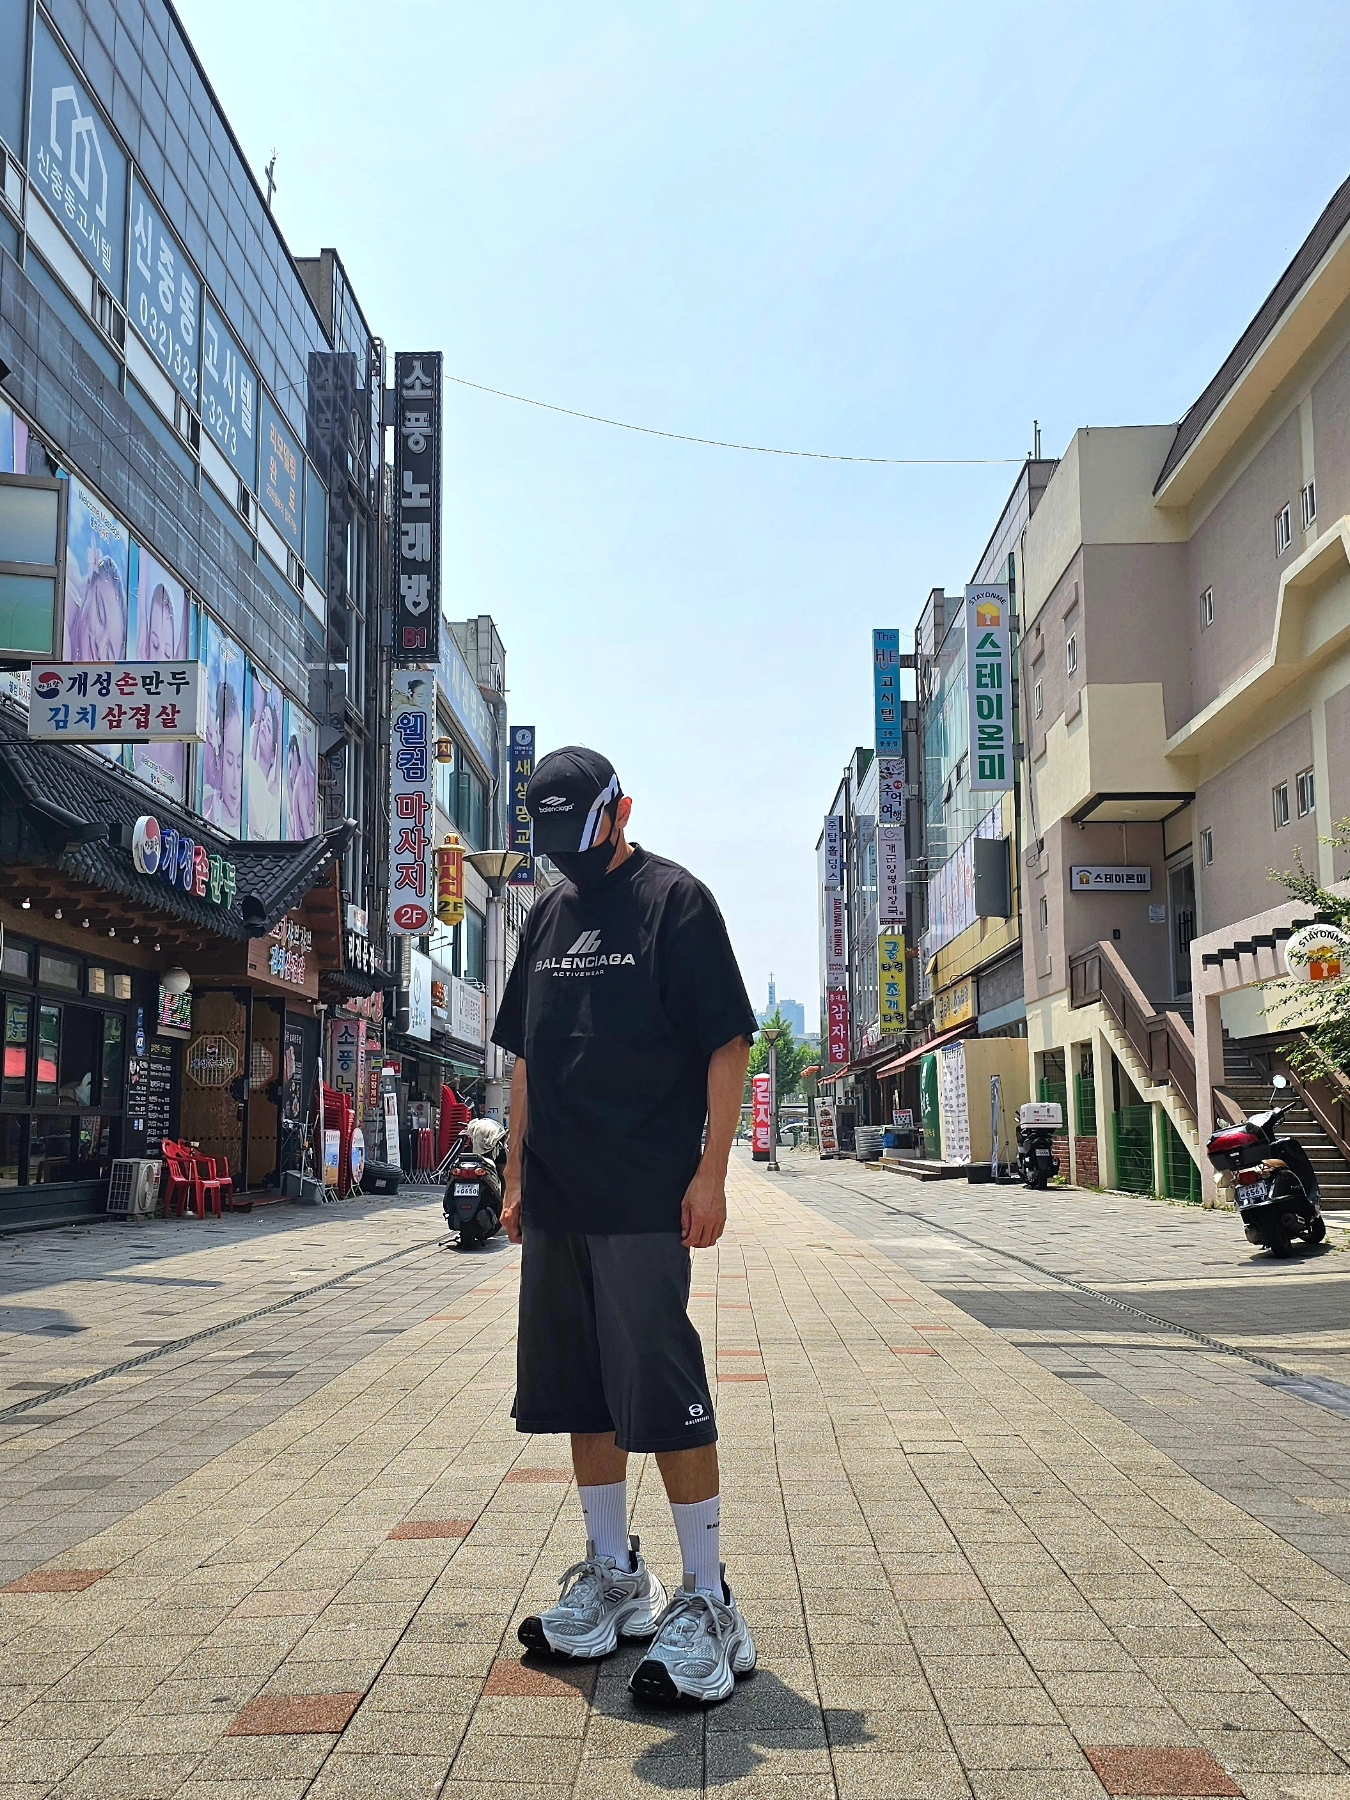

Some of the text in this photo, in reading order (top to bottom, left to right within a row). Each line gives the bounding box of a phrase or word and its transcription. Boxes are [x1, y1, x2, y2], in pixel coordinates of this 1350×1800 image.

[36, 146, 112, 275] 신중동고시텔
[139, 292, 239, 457] 032)322-3273
[968, 591, 1007, 606] STAYONME
[402, 626, 427, 649] B1
[876, 631, 897, 641] The
[66, 671, 190, 698] 개성손만두
[880, 675, 895, 722] 고시텔
[975, 633, 1006, 781] 스테이온미
[47, 703, 181, 731] 김치삼겹살
[394, 711, 430, 897] 웰컴 마사지
[538, 802, 574, 814] balenciaga
[161, 828, 237, 910] 개성손만두
[1093, 873, 1146, 884] 스테이온미
[401, 906, 423, 924] 2F
[438, 900, 464, 912] 2F
[833, 929, 842, 957] BUNKER
[1298, 929, 1348, 949] STAYONME
[534, 953, 636, 973] BALENCIAGA
[552, 969, 605, 977] ACTIVEWEAR
[831, 1003, 847, 1060] 감자탕
[1246, 1186, 1265, 1197] 6561
